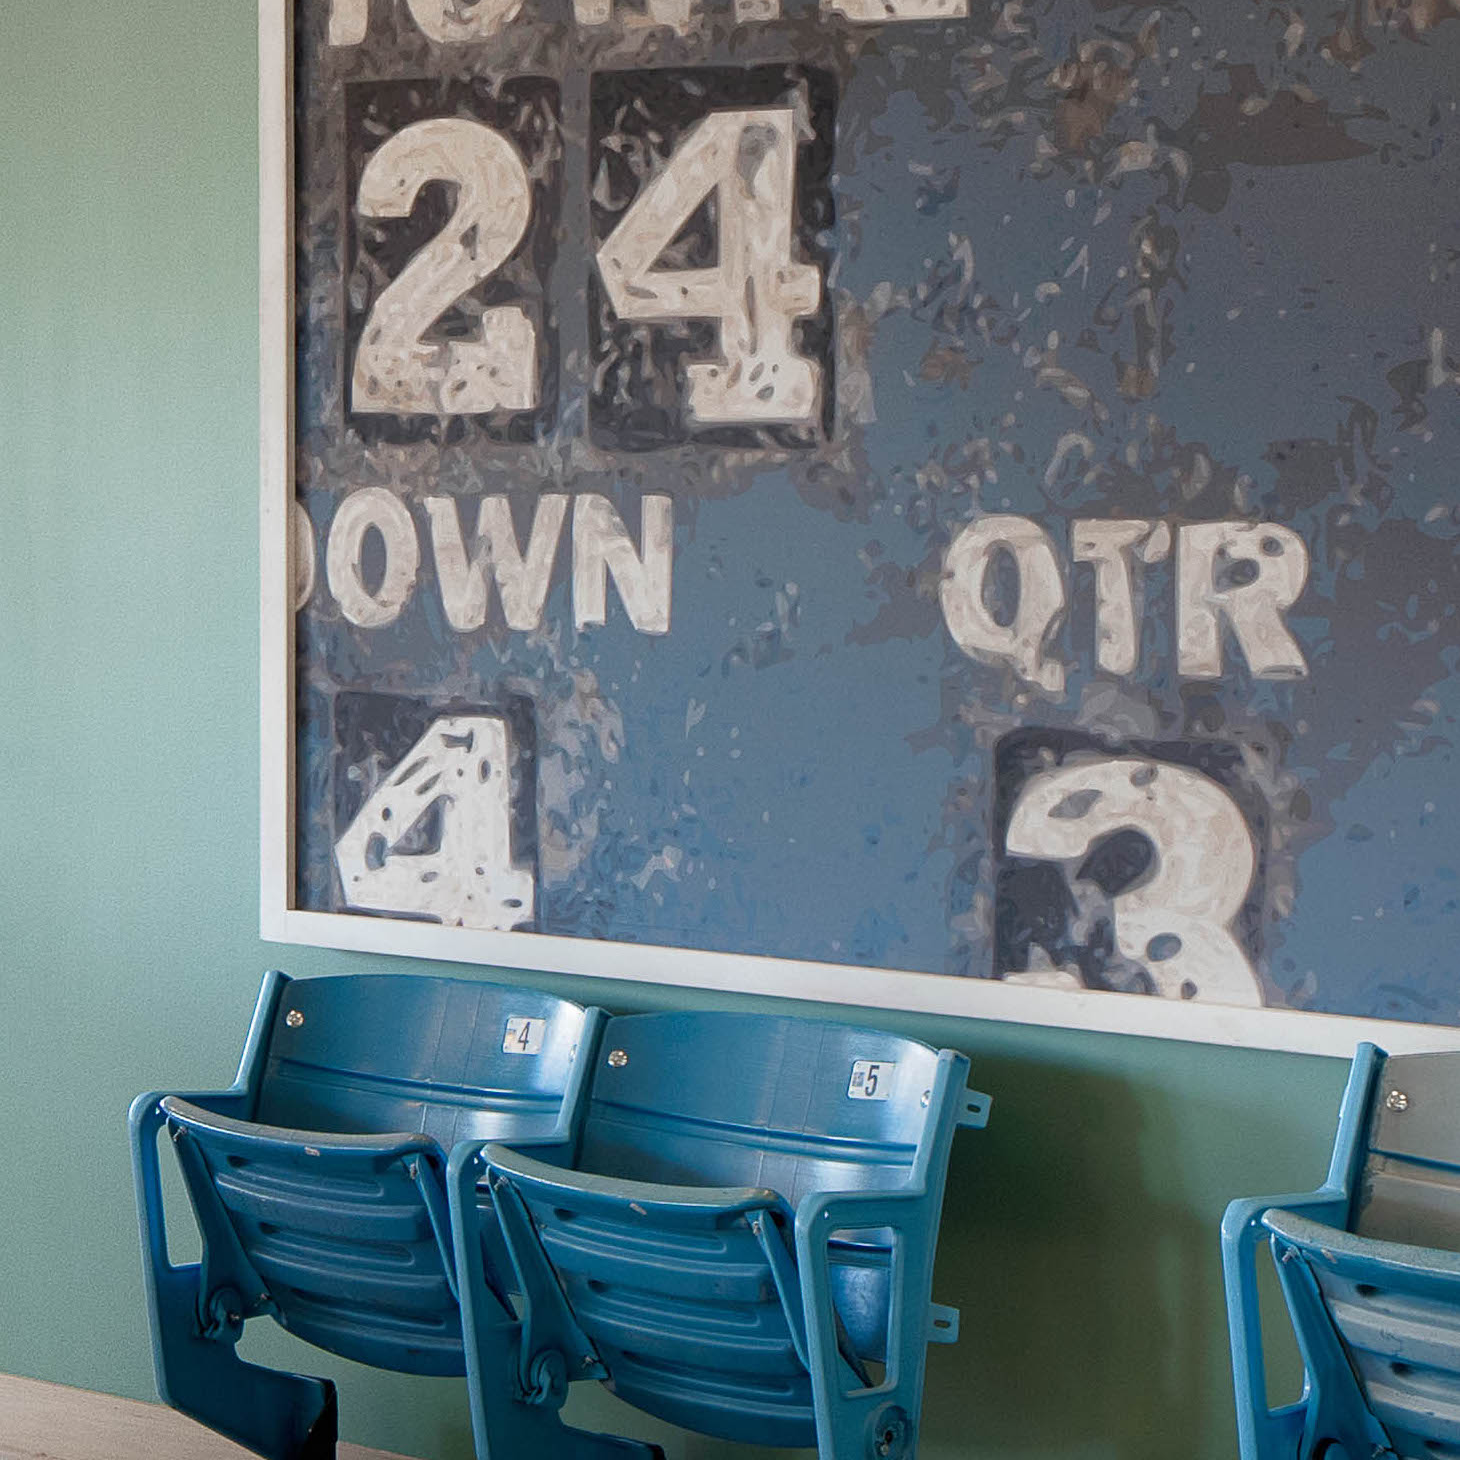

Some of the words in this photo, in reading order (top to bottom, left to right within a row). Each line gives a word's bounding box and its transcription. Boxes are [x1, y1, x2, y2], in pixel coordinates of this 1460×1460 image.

[351, 107, 820, 424] 24
[294, 486, 673, 635] OWN
[937, 514, 1311, 695] QTR
[333, 715, 535, 932] 4
[1000, 757, 1264, 1010] 3
[517, 1021, 531, 1052] 4
[864, 1064, 880, 1097] 5
